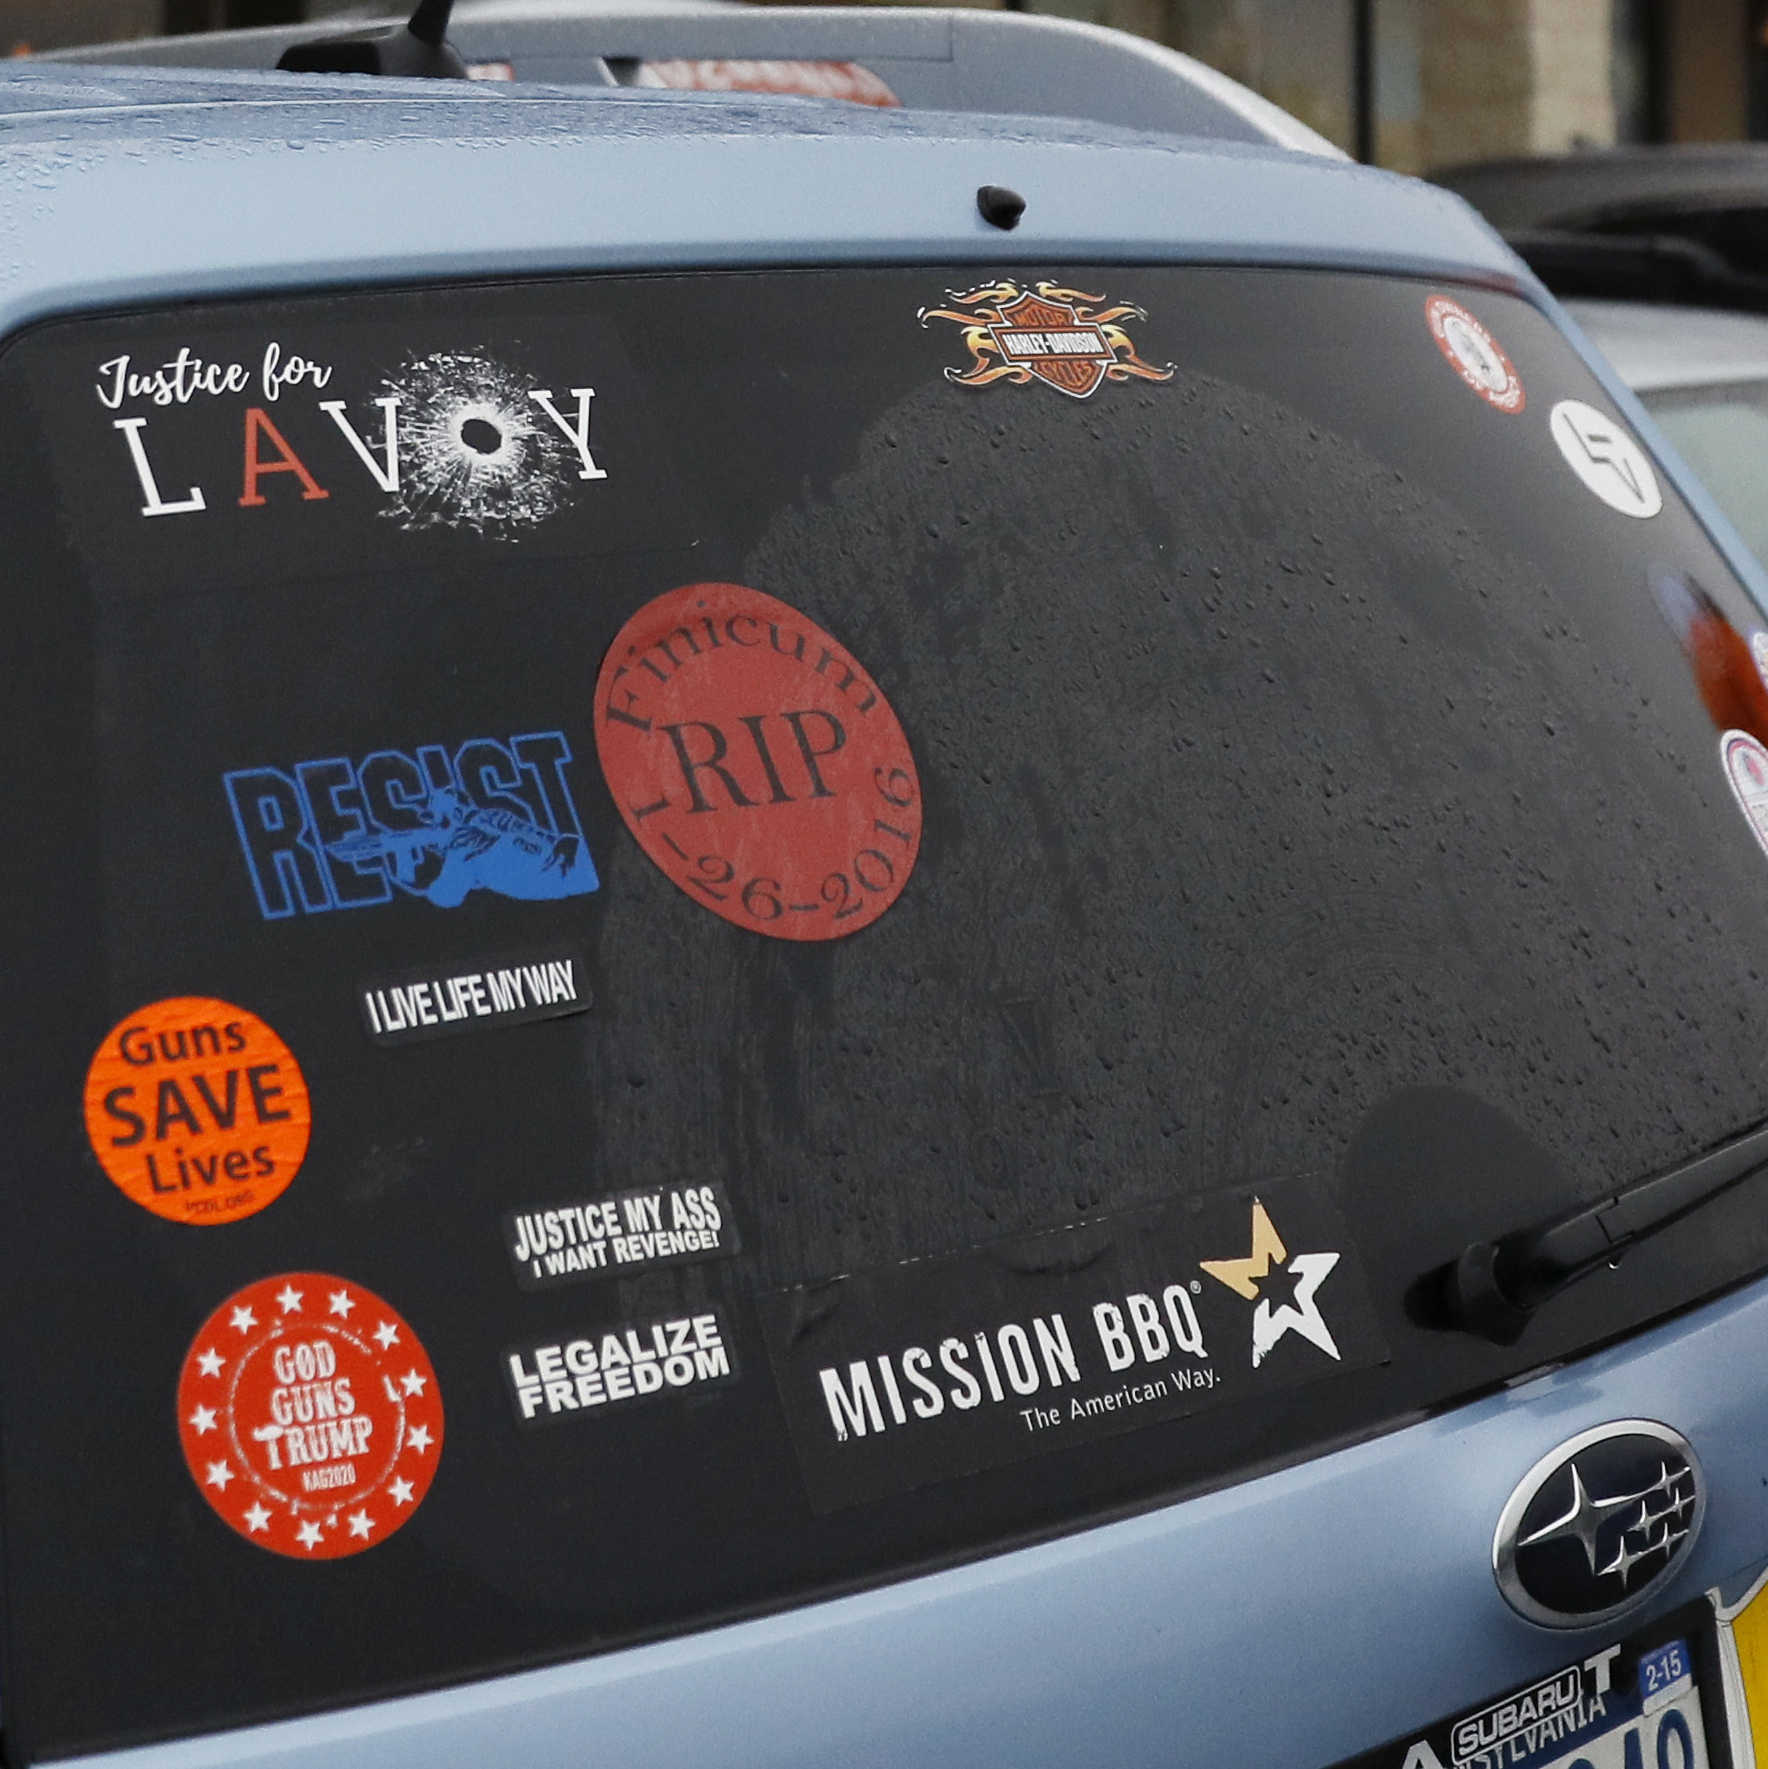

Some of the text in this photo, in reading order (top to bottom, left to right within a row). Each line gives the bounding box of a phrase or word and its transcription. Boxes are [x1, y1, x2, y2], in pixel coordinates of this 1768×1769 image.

[96, 342, 332, 409] Justice for
[1002, 332, 1105, 356] HARLEY-DAVIDSON
[605, 598, 878, 739] Finicum
[656, 708, 848, 815] RIP
[223, 731, 583, 921] RESIST
[377, 983, 439, 1032] LIVE
[433, 974, 492, 1022] LIFE
[486, 966, 527, 1012] MY
[522, 959, 578, 1006] WAY
[119, 1022, 247, 1067] Guns
[104, 1064, 291, 1147] SAVE
[147, 1145, 275, 1194] Lives
[515, 1186, 722, 1262] JUSTICE MY ASS
[533, 1229, 721, 1279] I WANT REVENGE!
[273, 1340, 337, 1385] GOD
[509, 1314, 723, 1388] LEGALIZE
[518, 1346, 731, 1419] FREEDOM
[819, 1284, 1209, 1441] MISSION BBQ
[271, 1378, 356, 1426] GUNS
[1020, 1366, 1222, 1431] The American Way.
[252, 1415, 374, 1471] TRUMP
[302, 1463, 357, 1493] KAG2020
[1646, 1649, 1682, 1691] 2-15
[1458, 1675, 1575, 1756] SUBARU
